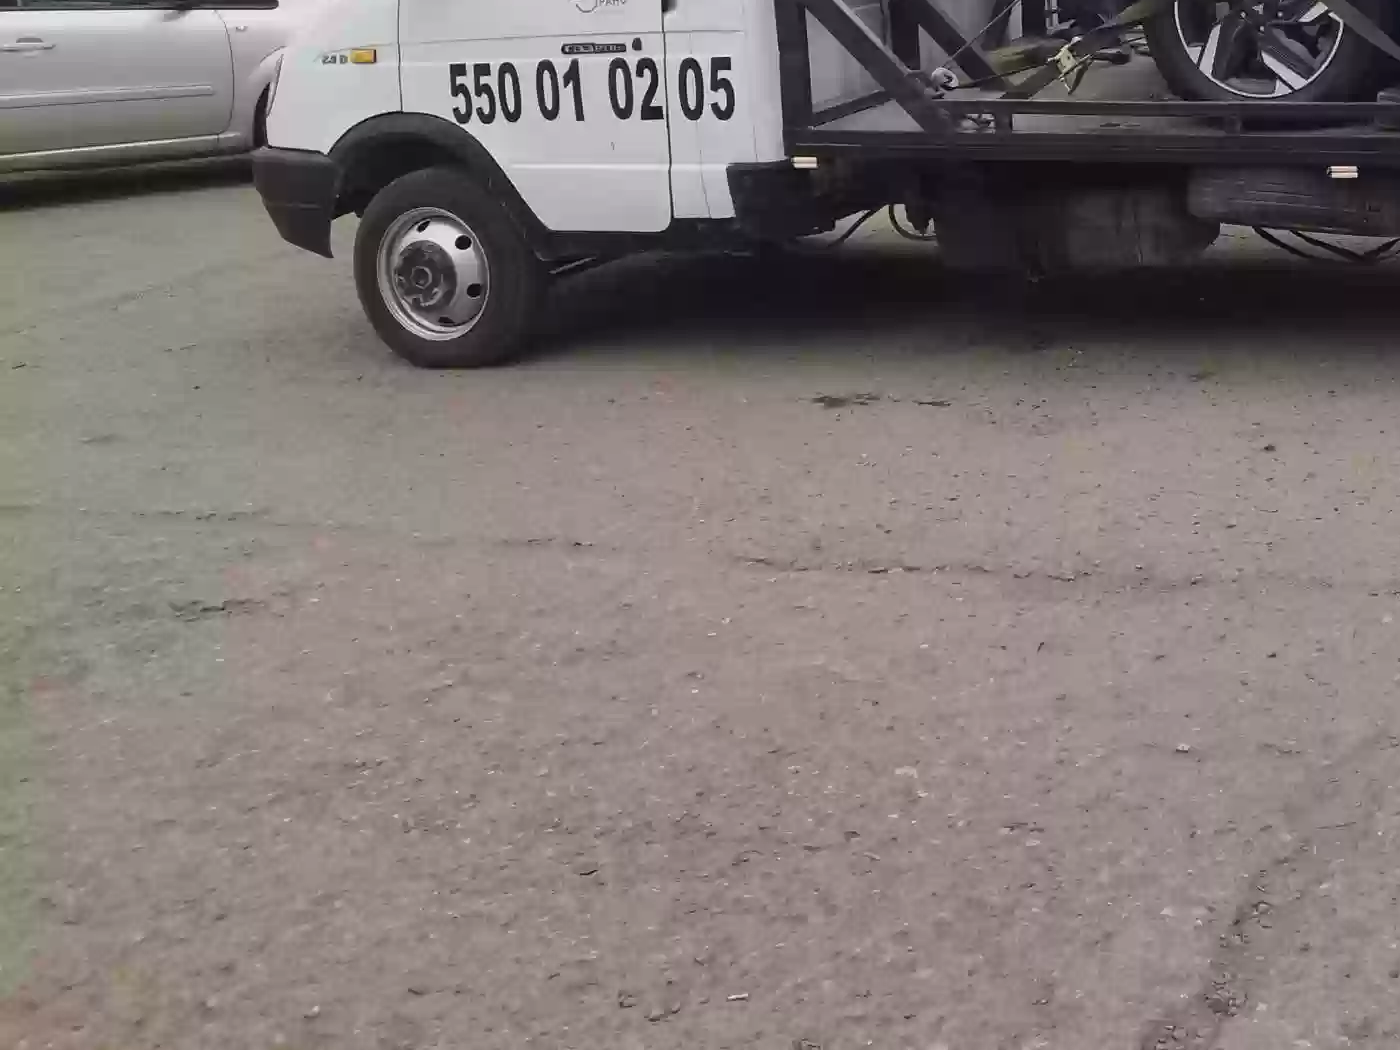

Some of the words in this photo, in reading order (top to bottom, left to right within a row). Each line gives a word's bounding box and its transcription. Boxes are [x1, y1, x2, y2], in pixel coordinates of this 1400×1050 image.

[449, 61, 522, 124] 550
[535, 58, 585, 121] 01
[607, 57, 664, 120] 02
[678, 56, 735, 120] 05
